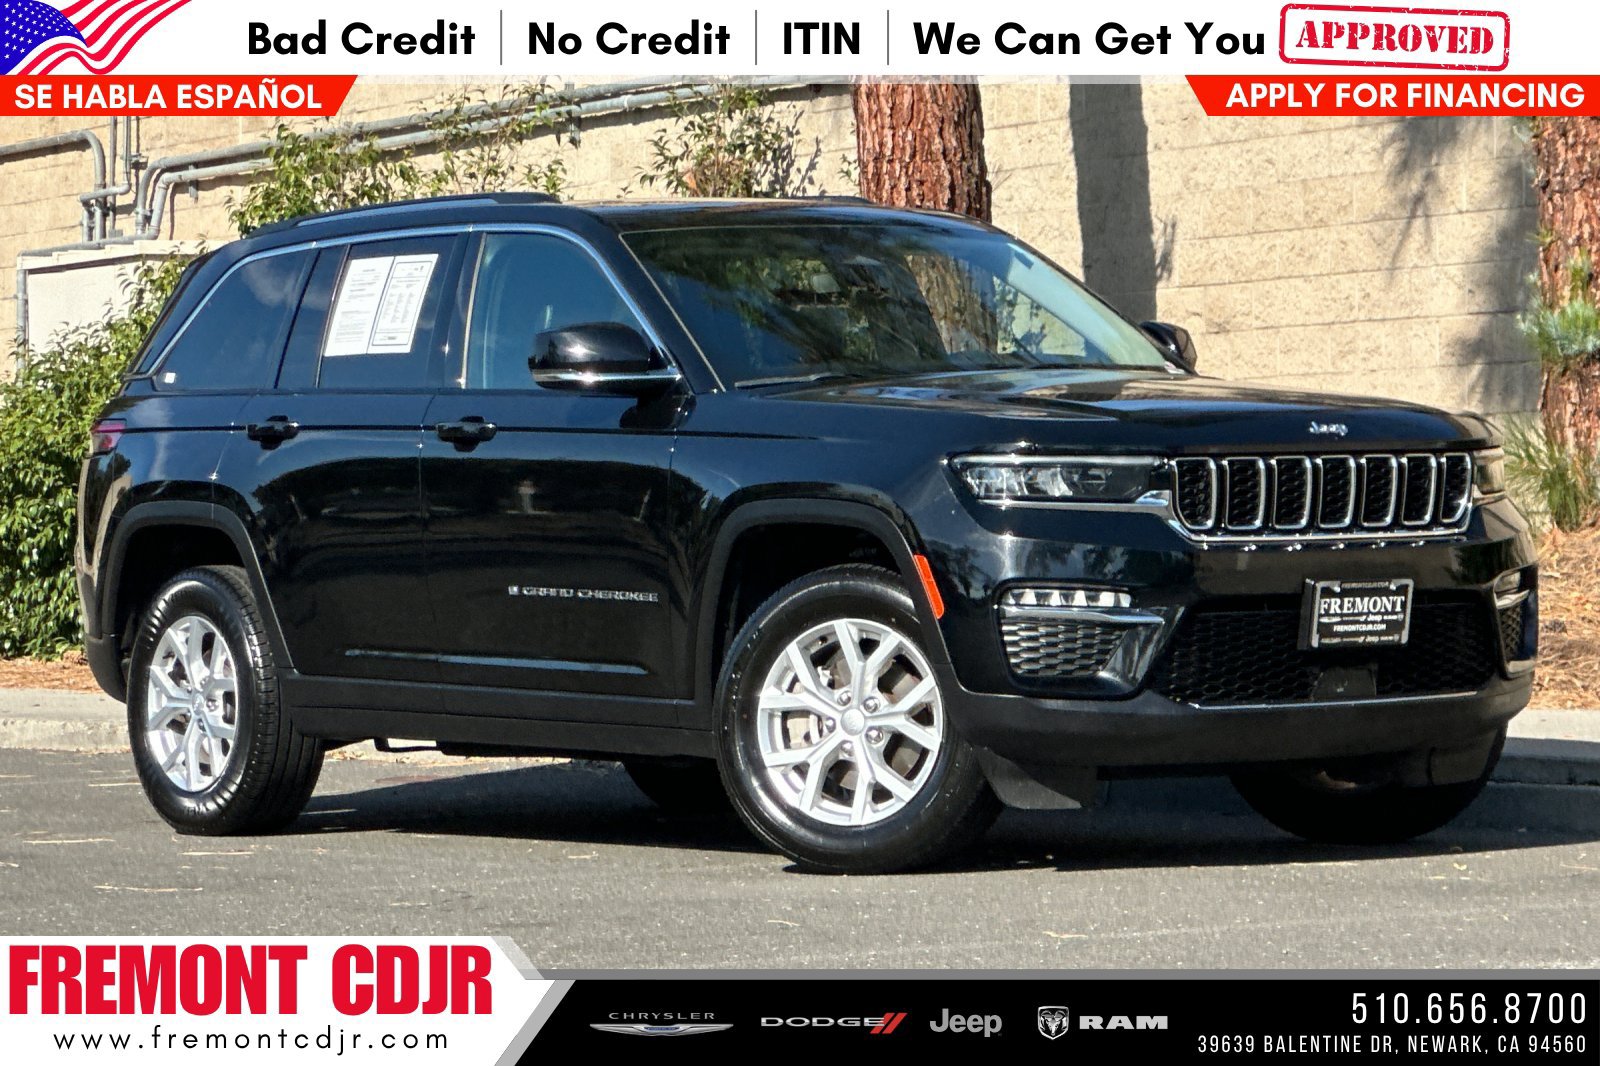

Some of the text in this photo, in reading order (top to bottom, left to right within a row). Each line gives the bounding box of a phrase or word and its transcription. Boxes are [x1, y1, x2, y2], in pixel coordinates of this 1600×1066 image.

[521, 586, 659, 602] GRAND CHEROKEE
[1319, 595, 1406, 614] FREMONT
